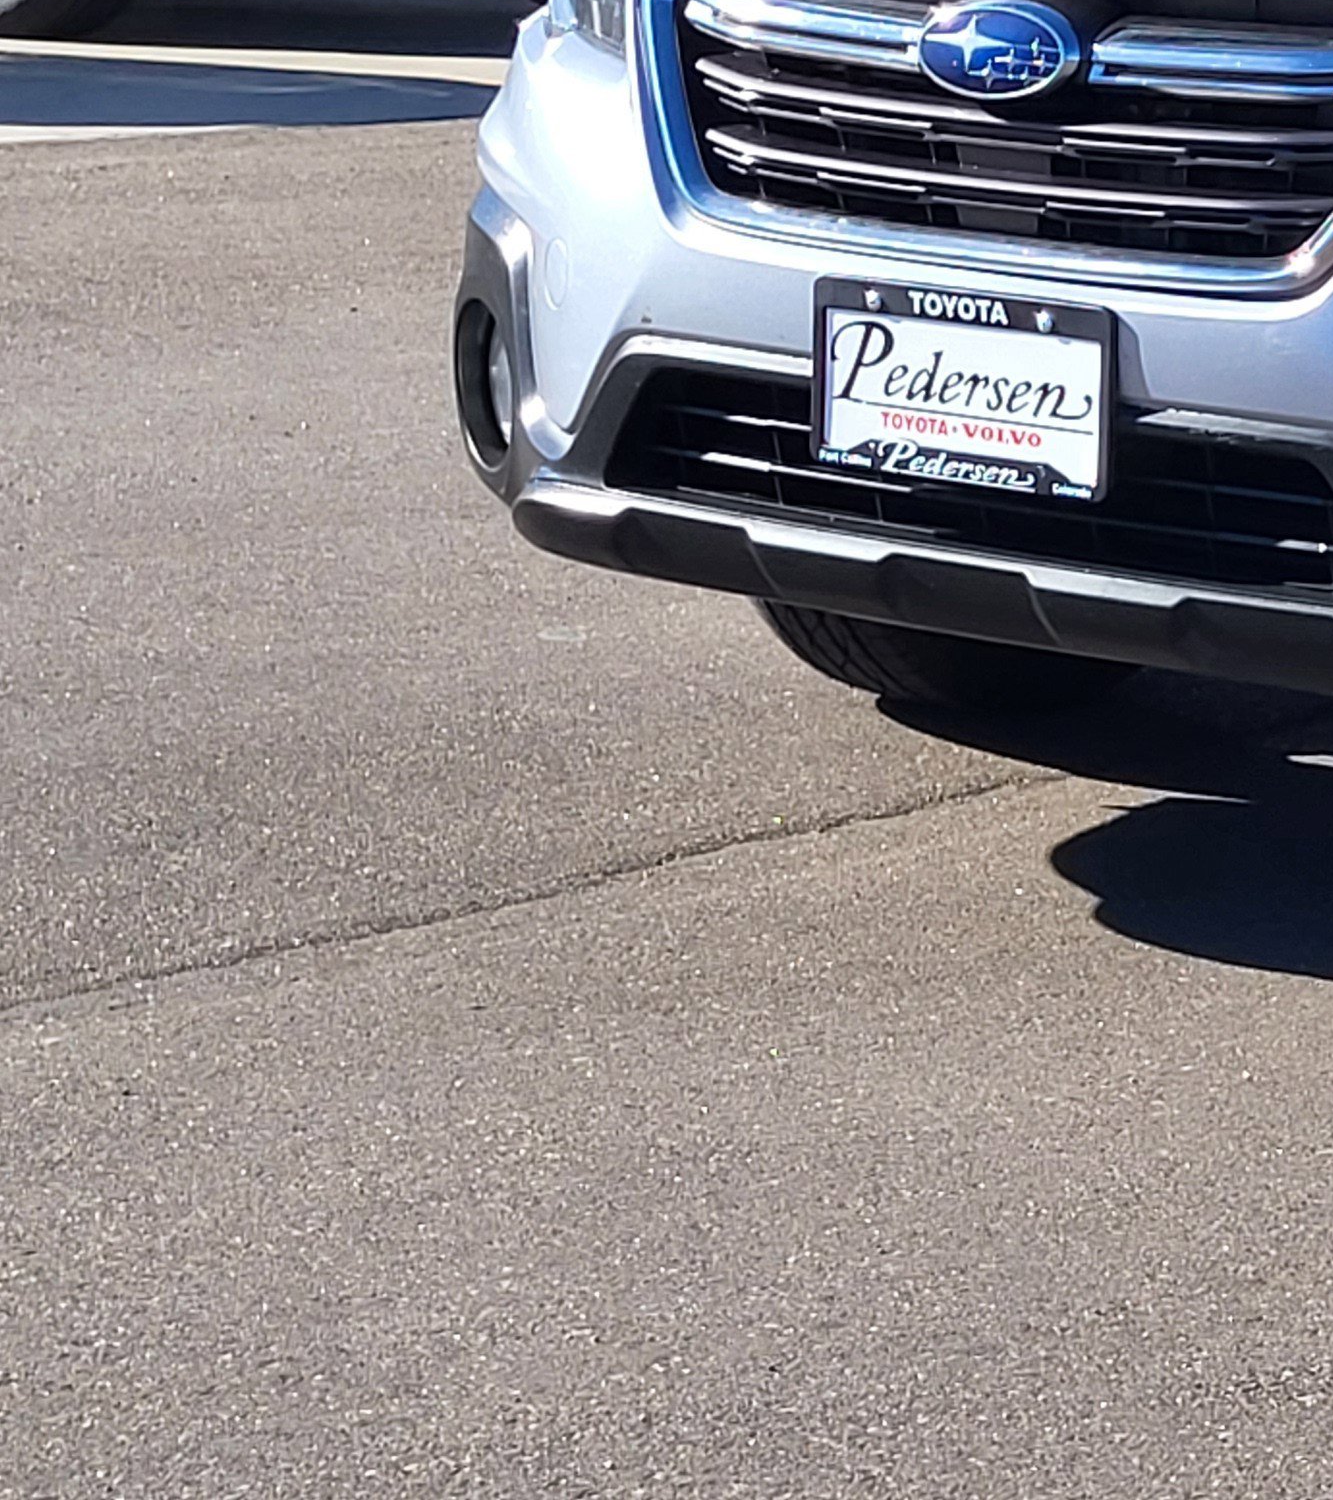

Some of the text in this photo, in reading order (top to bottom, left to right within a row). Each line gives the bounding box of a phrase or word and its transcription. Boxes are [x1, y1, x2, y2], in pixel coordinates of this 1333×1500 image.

[907, 289, 1010, 326] TOYOTA
[831, 320, 1094, 421] Pedersen
[880, 411, 1042, 448] TOYOTA VOLVO
[877, 438, 1035, 487] Pedersen
